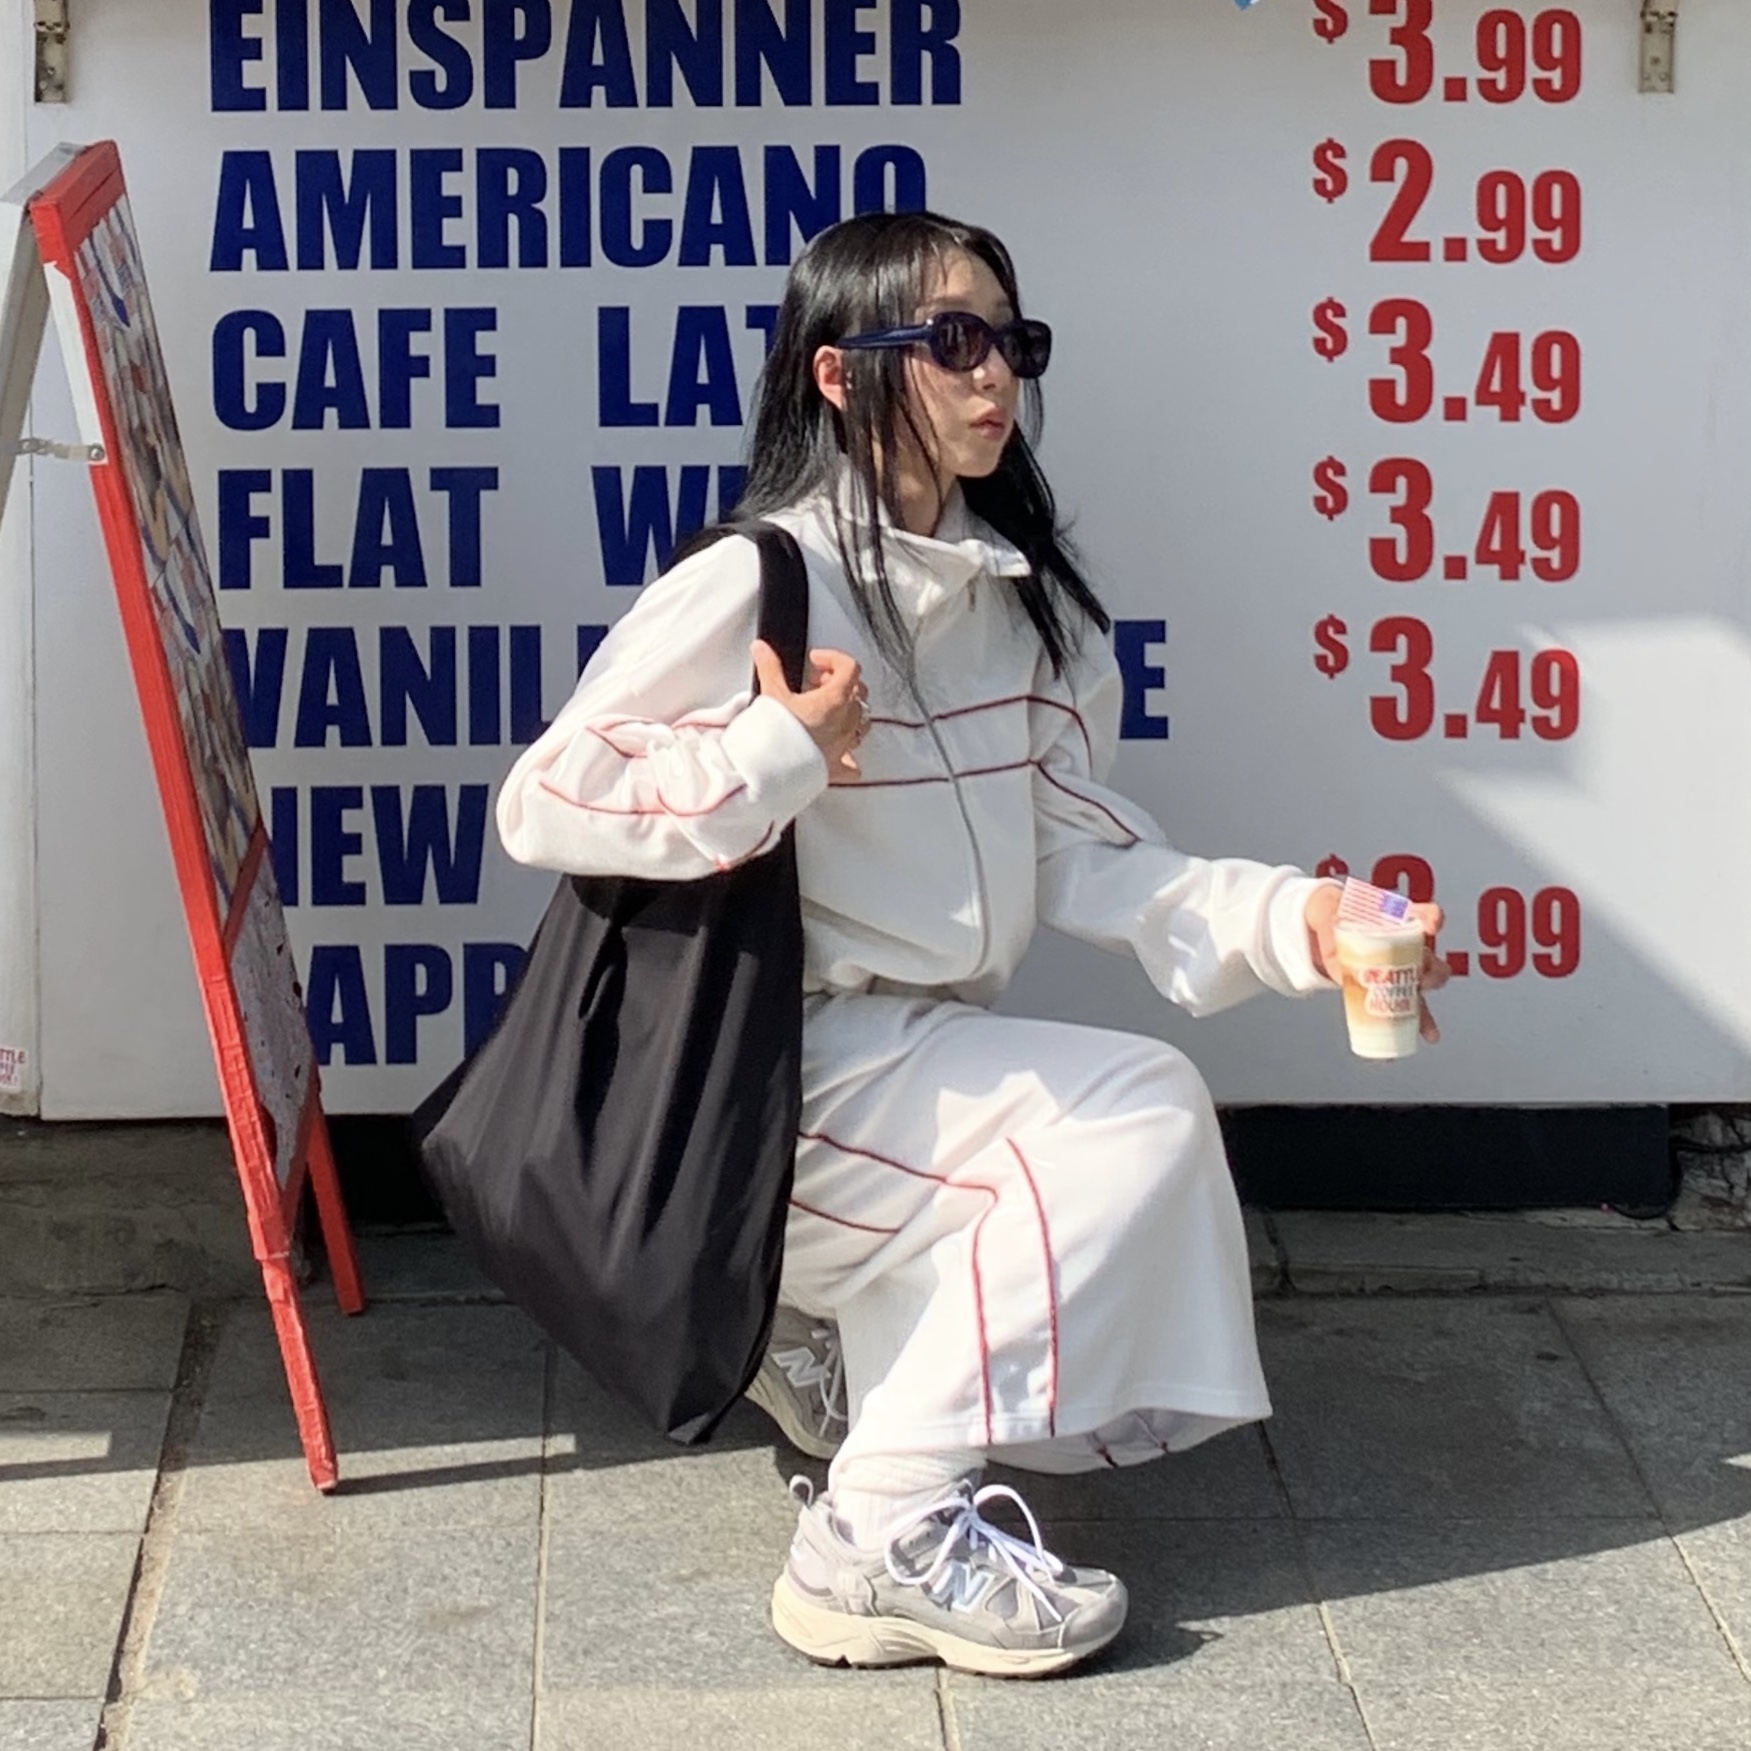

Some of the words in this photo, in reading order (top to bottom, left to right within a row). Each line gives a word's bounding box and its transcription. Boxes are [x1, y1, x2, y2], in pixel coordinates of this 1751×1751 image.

[211, 0, 961, 111] EINSPANNER
[210, 145, 928, 271] AMERICANO
[212, 307, 501, 430] CAFE
[218, 467, 498, 588] FLAT
[221, 625, 608, 748] VANIL
